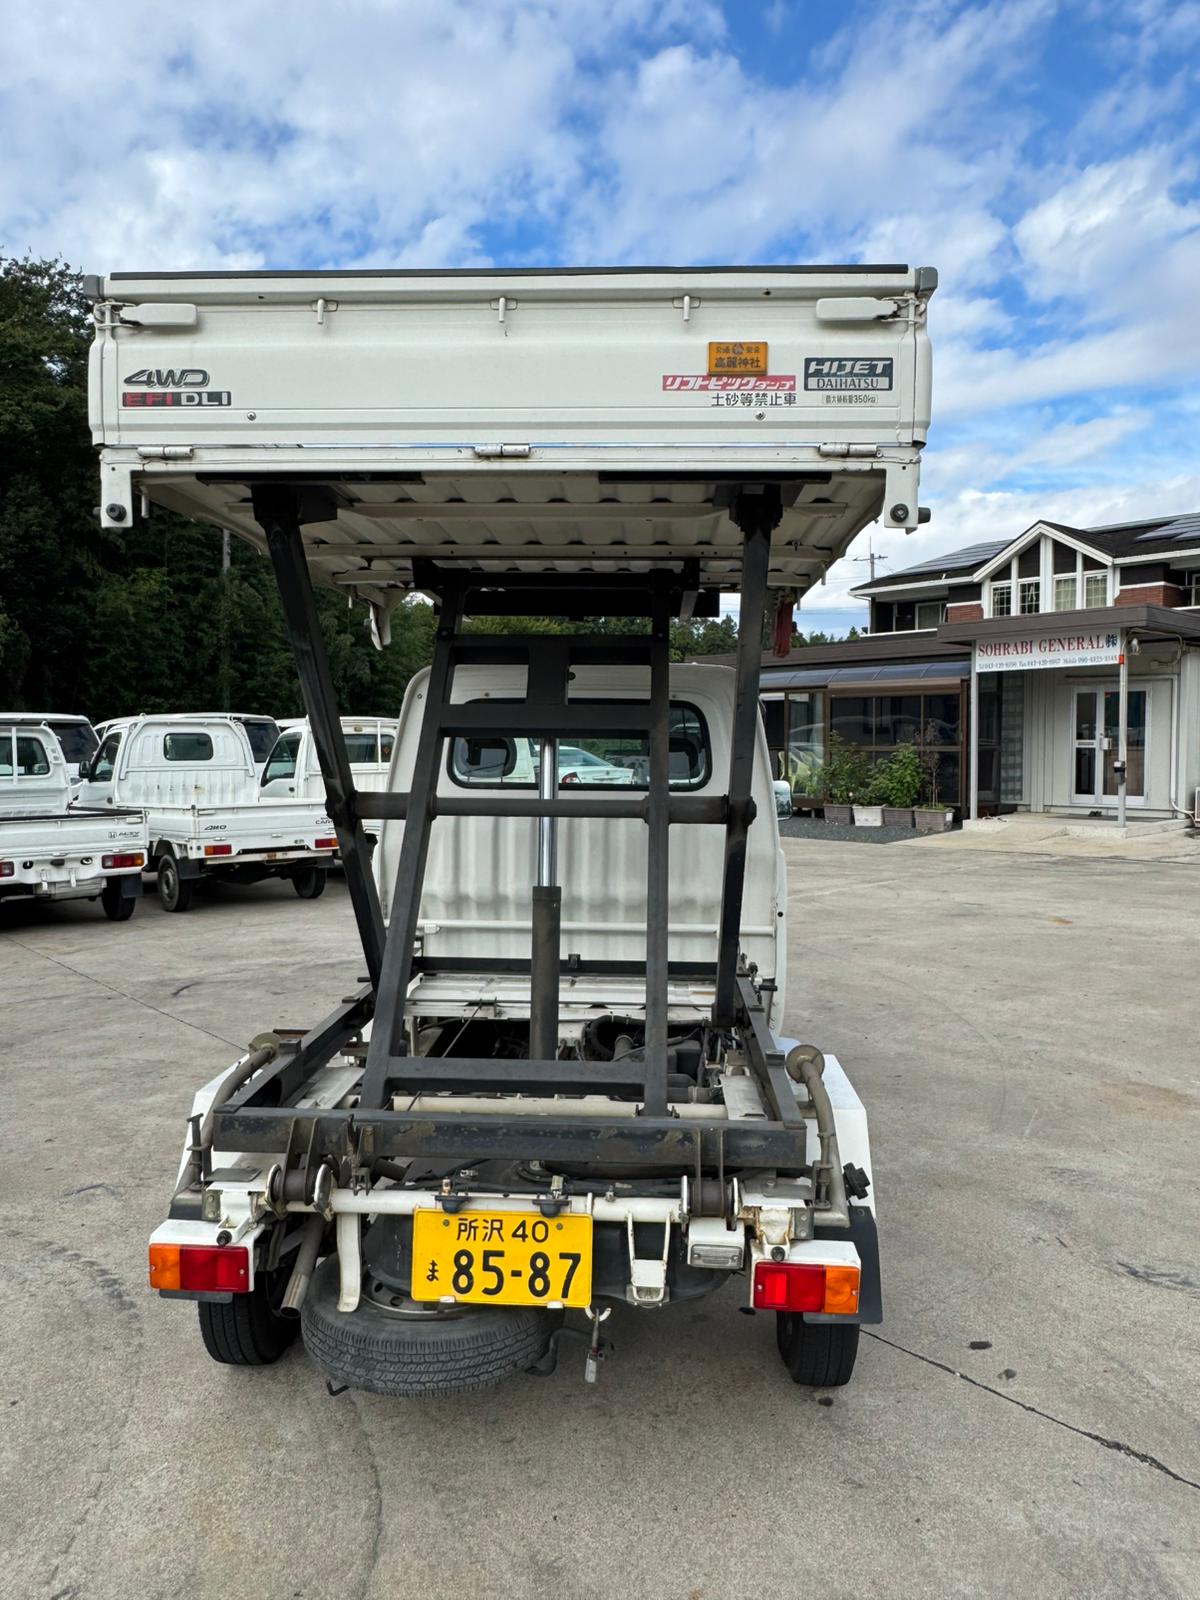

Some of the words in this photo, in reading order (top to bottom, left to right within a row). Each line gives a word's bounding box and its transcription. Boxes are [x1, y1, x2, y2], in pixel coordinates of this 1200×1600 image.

[808, 361, 892, 374] HIJET
[123, 369, 210, 388] 4WD
[817, 378, 879, 389] DAIHATSU
[126, 393, 174, 407] EFI
[180, 392, 228, 406] DLI
[711, 392, 797, 407] 土砂等禁止車
[978, 640, 1033, 657] SOHRABI
[1038, 635, 1104, 653] GENERAL
[456, 1218, 504, 1242] 所沢
[511, 1219, 549, 1243] 40
[426, 1259, 439, 1282] ま
[452, 1249, 581, 1299] 85-87
